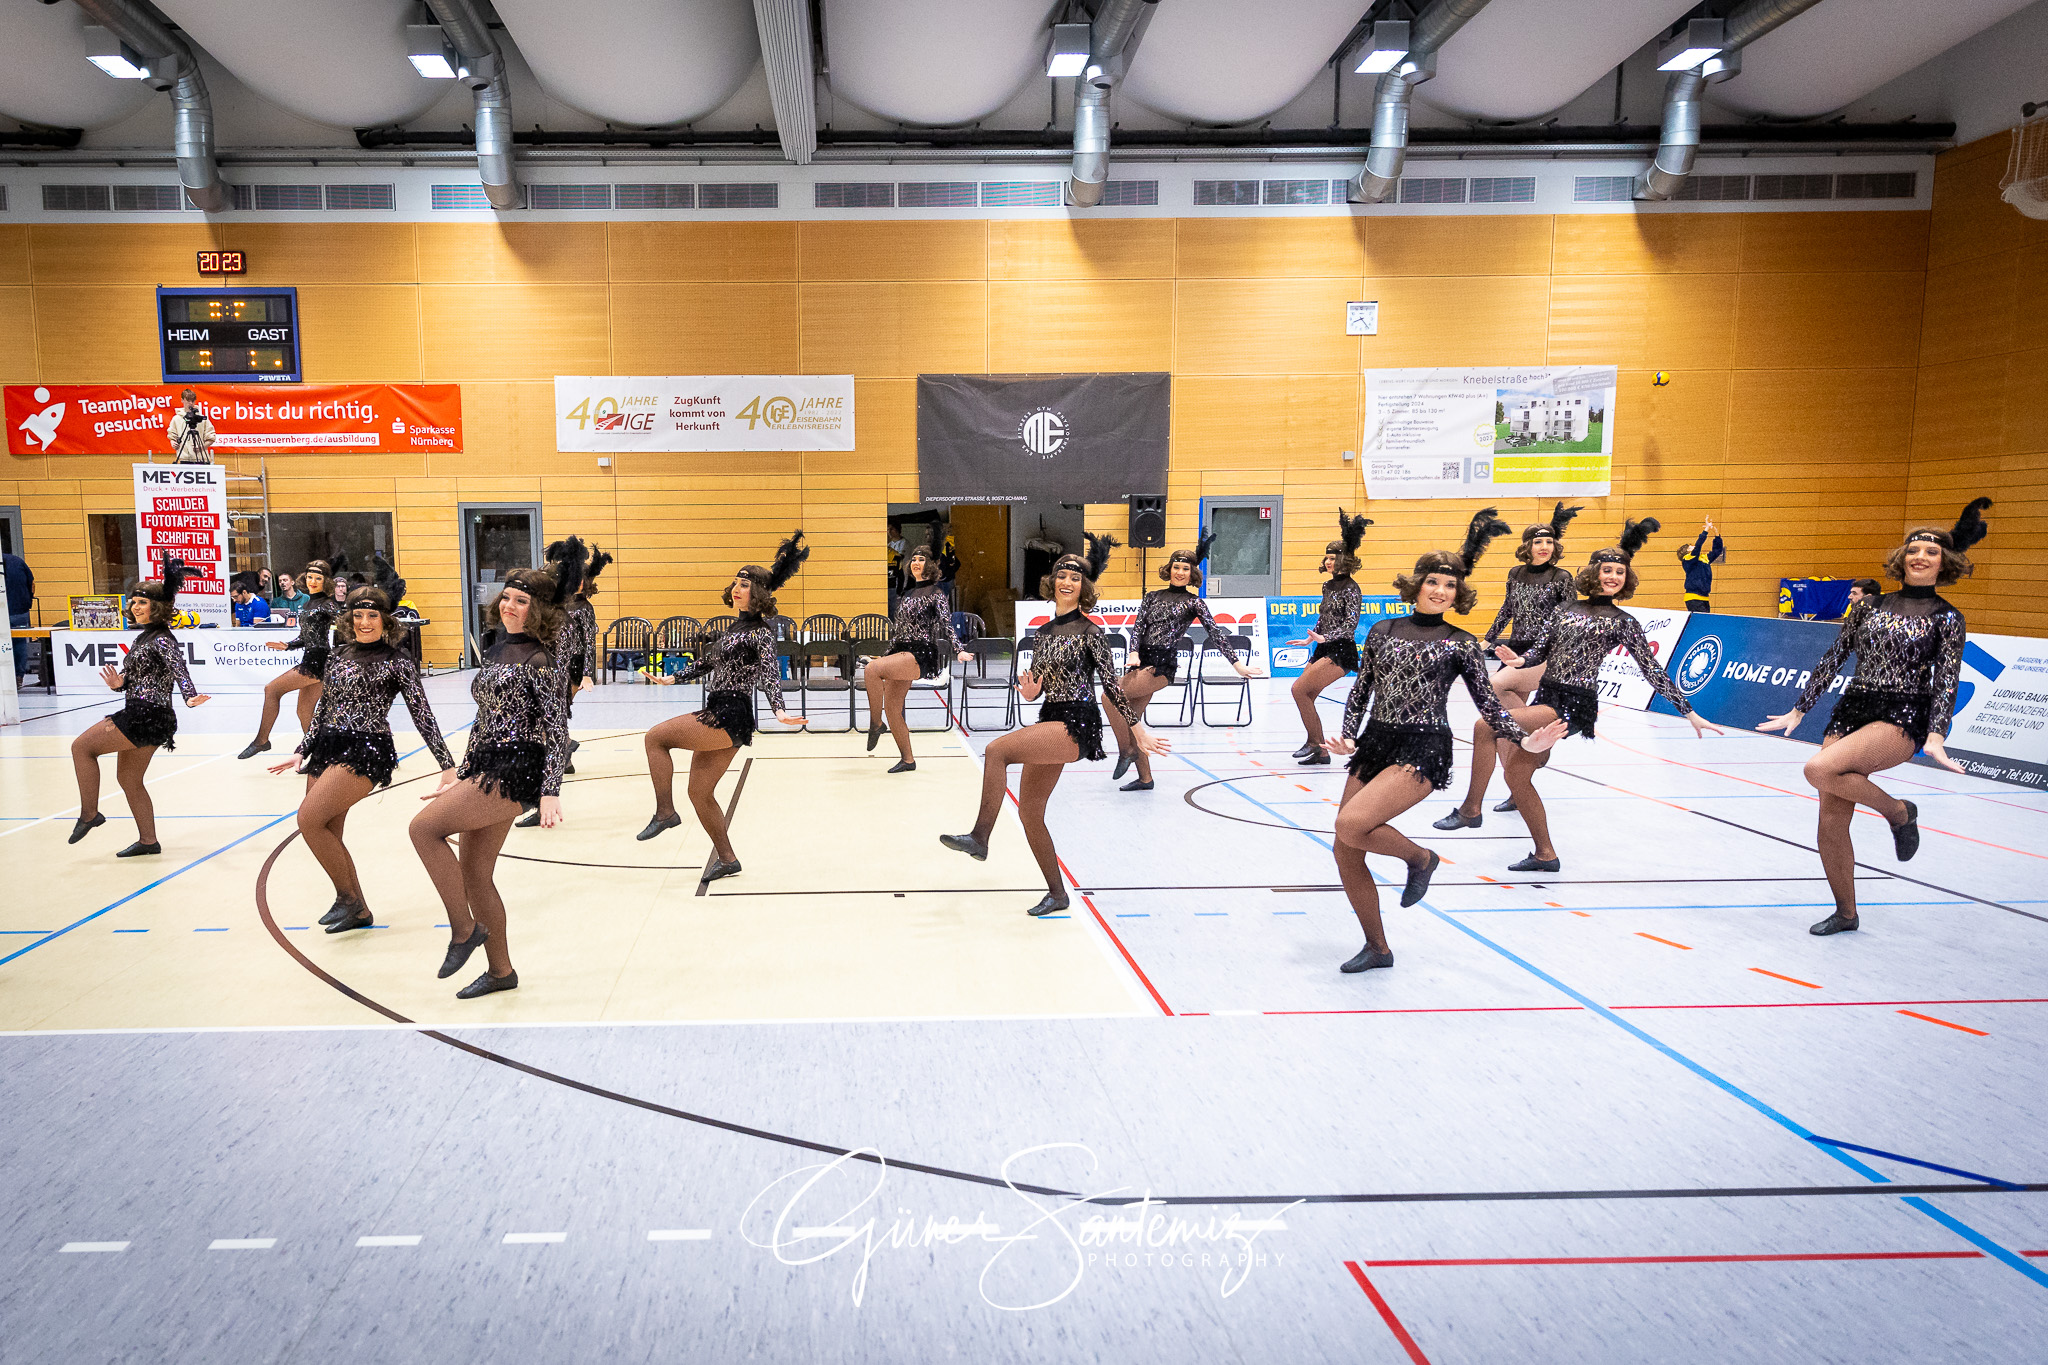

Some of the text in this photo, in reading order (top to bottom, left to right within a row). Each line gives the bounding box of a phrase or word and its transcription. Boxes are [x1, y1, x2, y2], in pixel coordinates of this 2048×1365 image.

[200, 252, 242, 271] 20 23
[167, 328, 289, 341] HEIM GAST
[1463, 375, 1528, 384] Knebelstraße
[78, 394, 173, 416] Teamplayer
[621, 396, 659, 408] JAHRE
[673, 396, 721, 408] ZugKunft
[800, 397, 844, 411] JAHRE
[235, 401, 273, 420] bist
[278, 401, 304, 420] du
[309, 400, 379, 424] richtig.
[669, 408, 726, 418] kommt von
[94, 413, 164, 437] gesucht!
[624, 413, 656, 430] IGE
[675, 421, 720, 431] Herkunft
[409, 424, 455, 436] Sparkasse
[410, 435, 453, 447] Nürnberg
[142, 470, 217, 485] MEYSEL
[143, 485, 162, 493] Druck
[155, 497, 205, 511] SCHILDER
[145, 514, 215, 528] FOTOTAPETEN
[156, 530, 209, 545] SCHRIFTEN
[150, 548, 216, 561] KLBEFOLIEN
[1270, 603, 1297, 616] DER
[1643, 617, 1672, 634] Gino
[214, 655, 300, 666] Werbetechnik
[1023, 651, 1034, 660] Ih
[1722, 660, 1773, 684] HOME
[1771, 667, 1797, 687] OF
[1992, 688, 2026, 701] LUDWIG
[1975, 712, 2045, 731] BETREUUNG UND
[1966, 724, 2017, 740] IMMOBILIEN
[1968, 761, 2002, 779] Schwaig
[2005, 768, 2022, 781] Tel:
[2020, 770, 2043, 786] 0911
